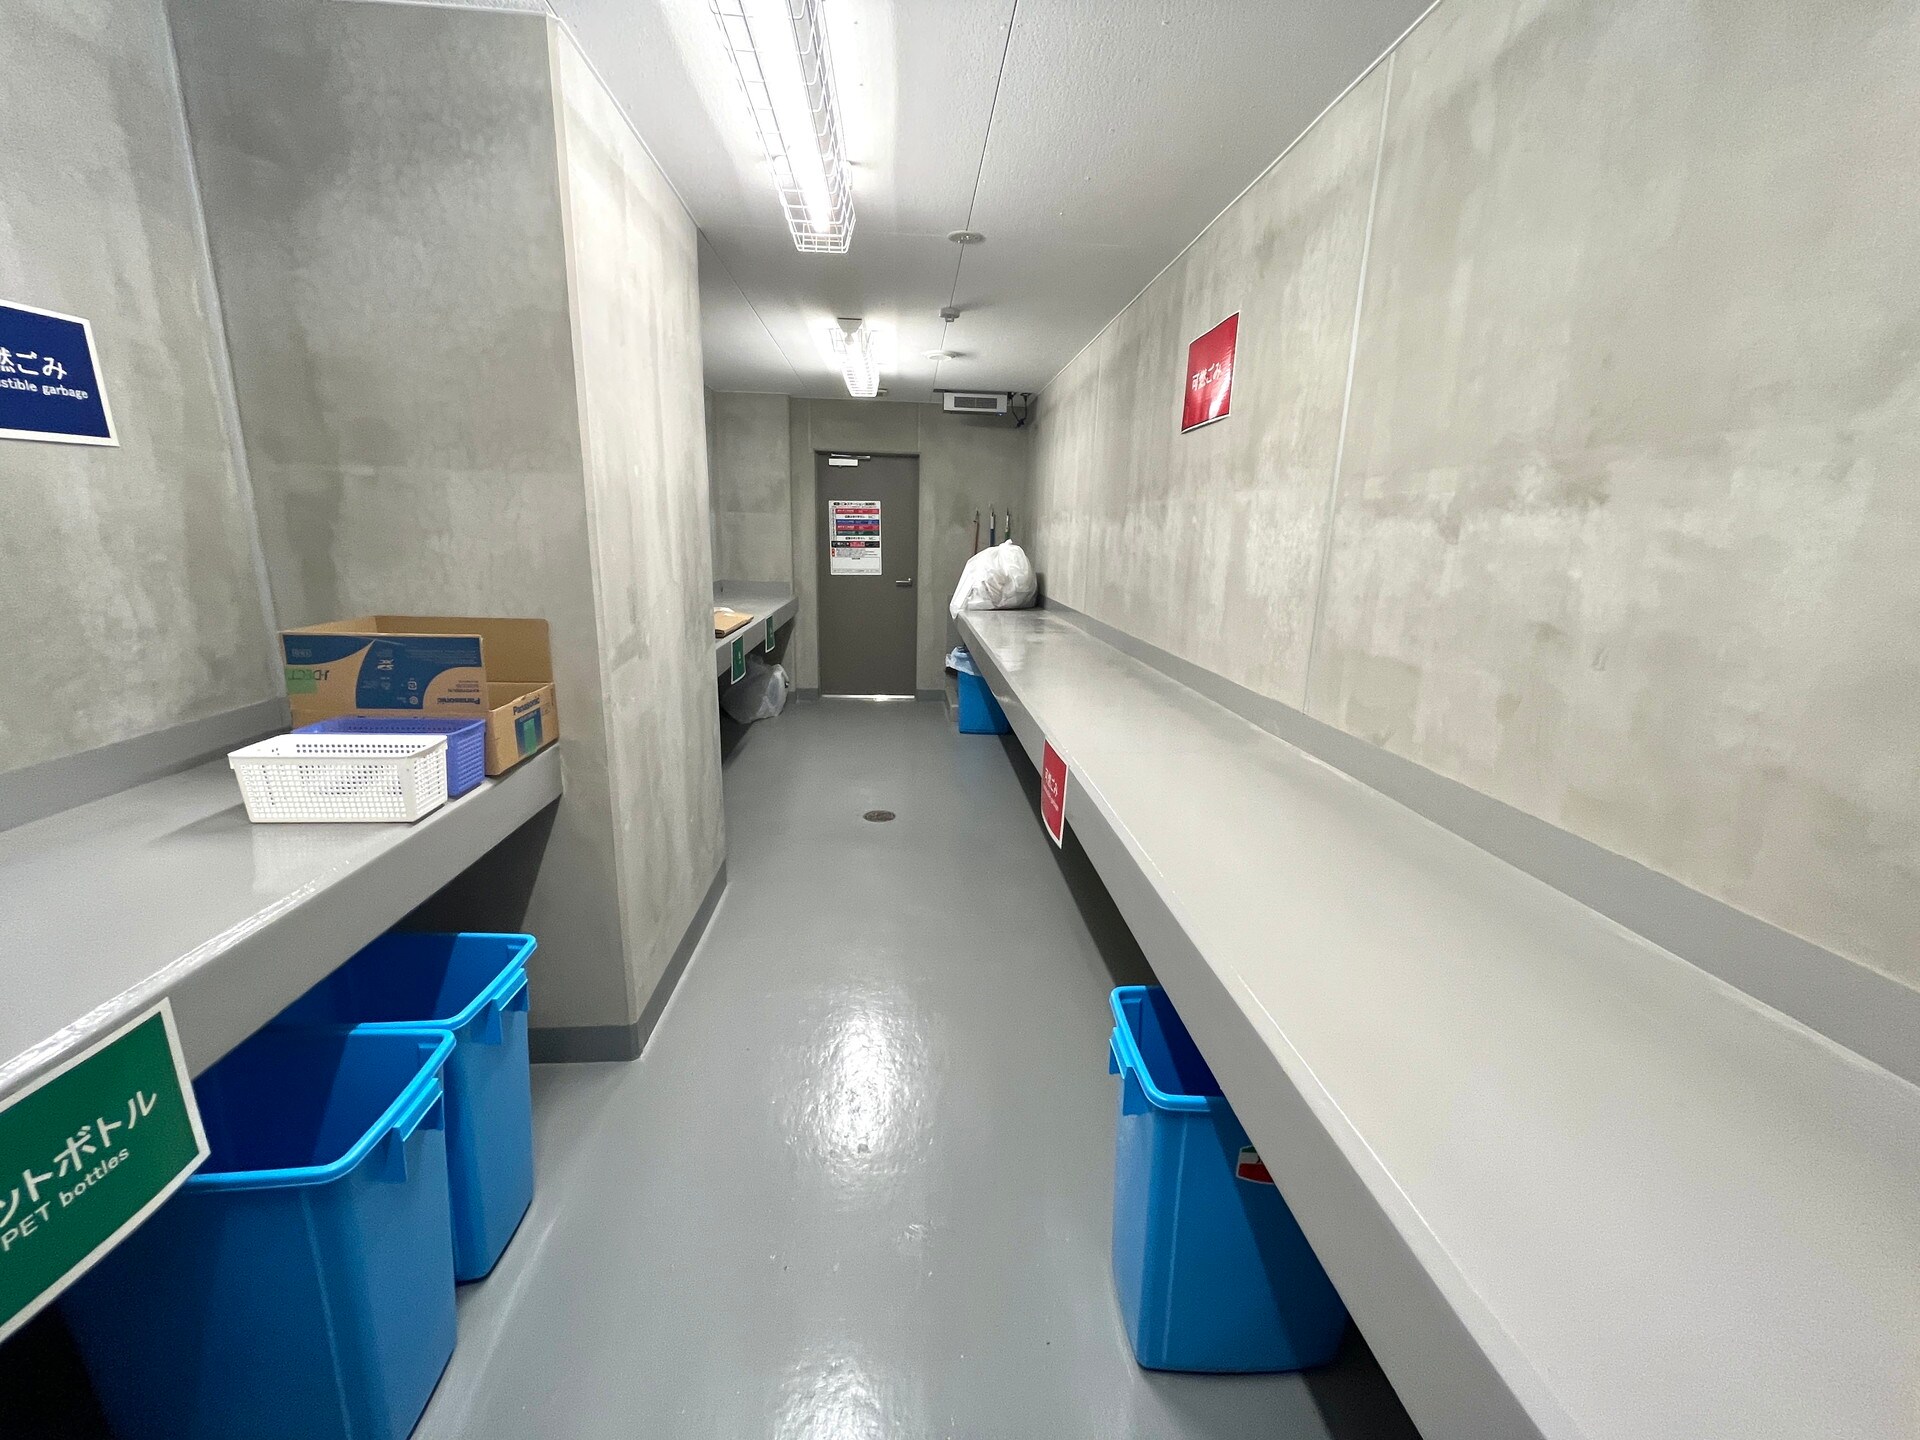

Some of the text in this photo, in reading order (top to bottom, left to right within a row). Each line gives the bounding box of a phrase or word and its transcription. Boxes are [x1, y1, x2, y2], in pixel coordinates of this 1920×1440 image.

[0, 378, 89, 400] stible garbage
[437, 697, 481, 706] Panasonic
[512, 695, 541, 716] Panasonic
[0, 1148, 130, 1252] PET bottles
